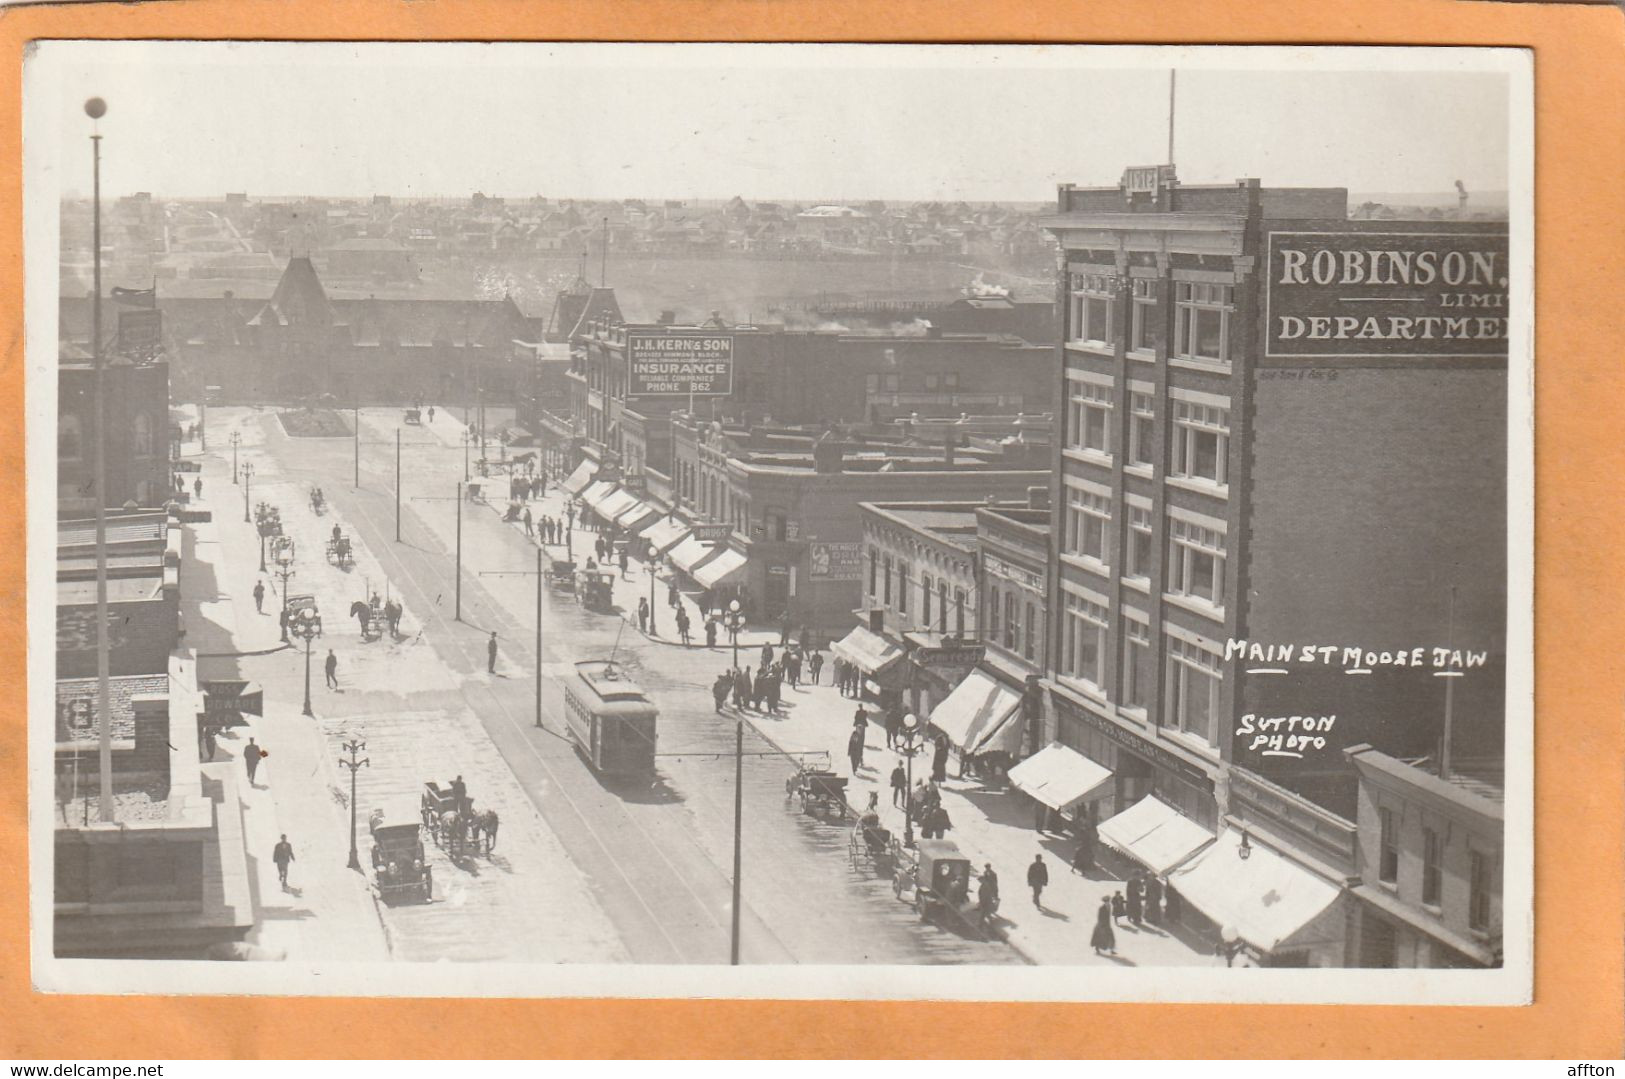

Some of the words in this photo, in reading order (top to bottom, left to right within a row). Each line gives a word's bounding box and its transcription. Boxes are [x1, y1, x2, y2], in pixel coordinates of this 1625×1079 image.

[1279, 250, 1508, 287] ROBINSON,
[1440, 293, 1508, 307] LIMI
[657, 340, 692, 350] KERN
[693, 341, 701, 350] &
[703, 340, 729, 350] SON
[634, 364, 726, 374] INSURANCE
[646, 382, 680, 391] PHONE
[700, 528, 727, 538] DRUGS
